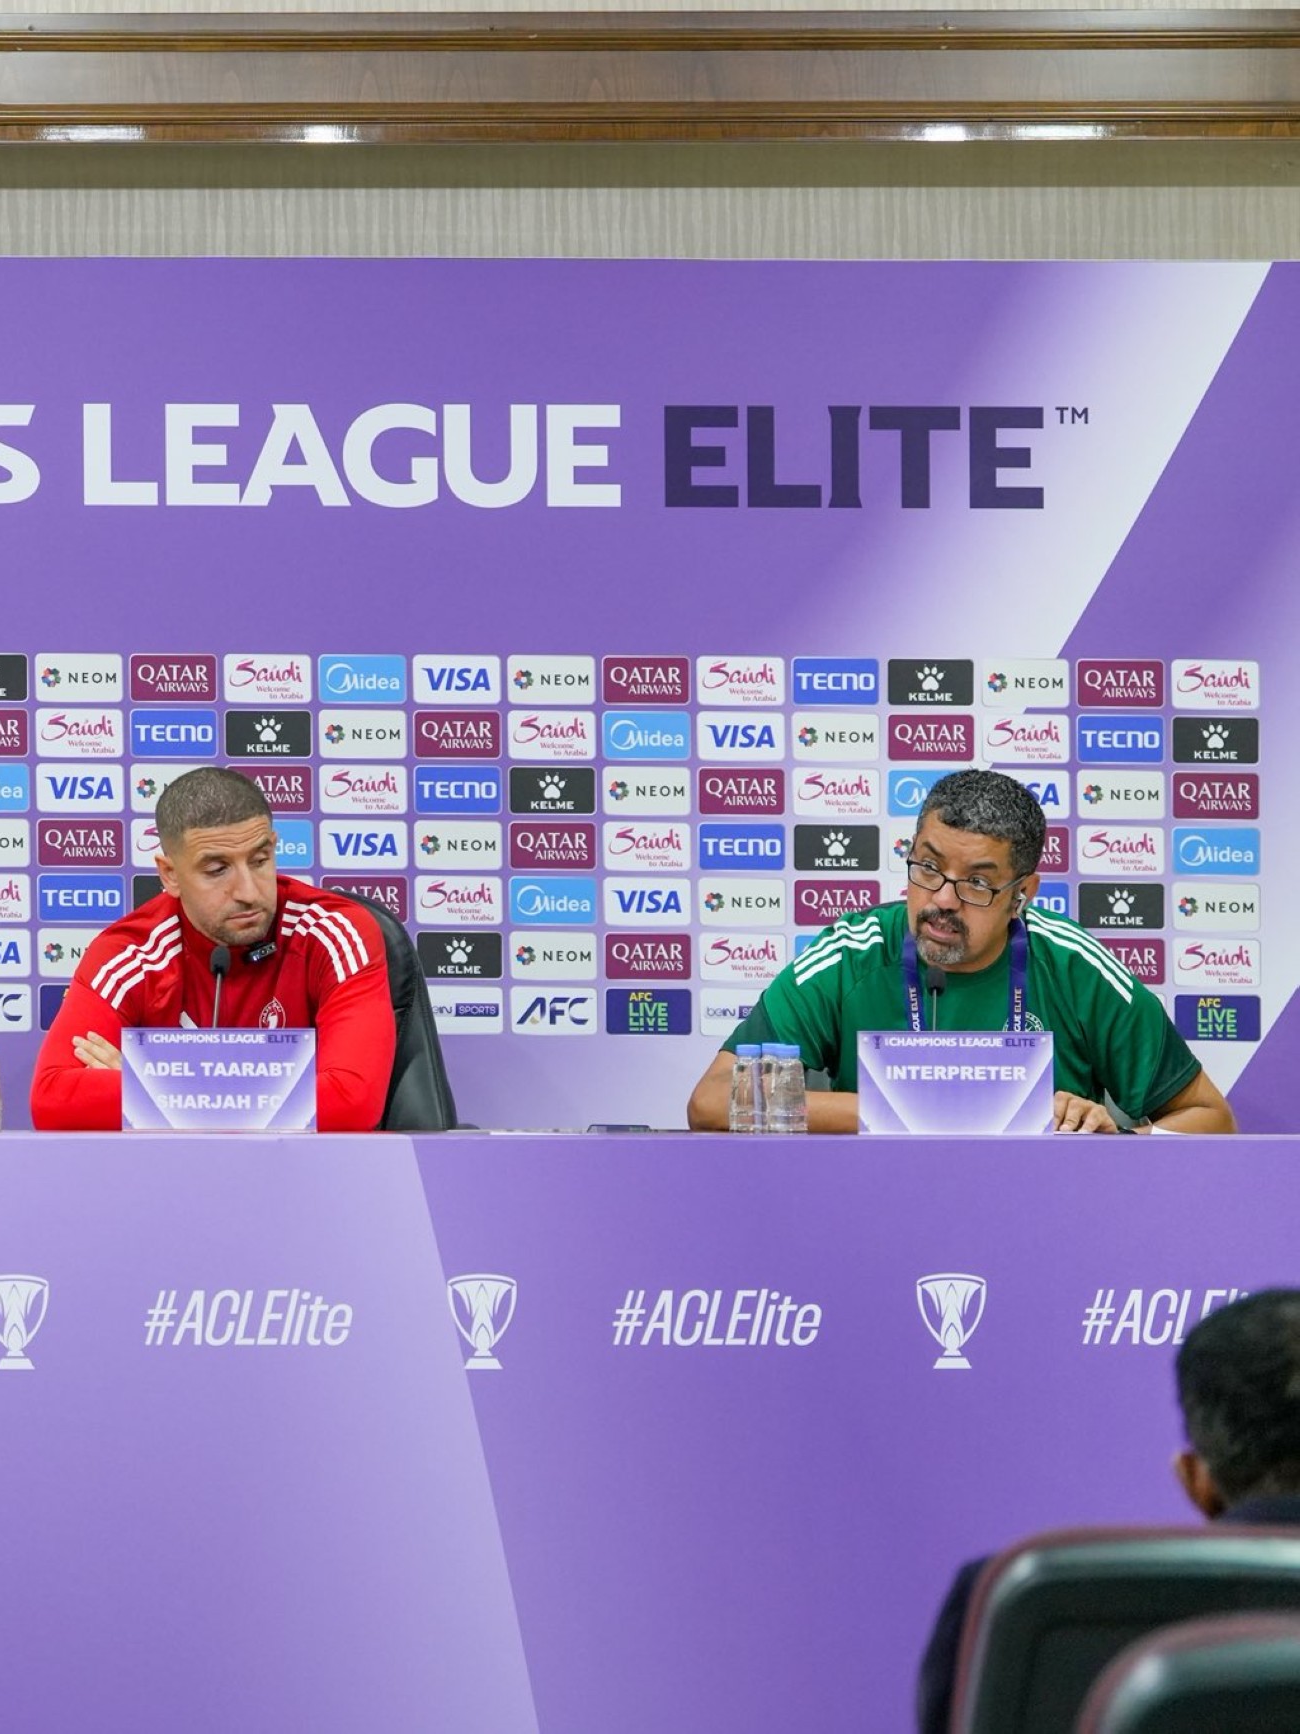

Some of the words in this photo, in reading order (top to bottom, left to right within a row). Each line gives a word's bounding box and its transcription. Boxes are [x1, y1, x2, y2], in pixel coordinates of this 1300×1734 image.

[83, 403, 621, 508] LEAGUE
[663, 405, 1044, 509] ELITE
[68, 672, 116, 684] NEOM
[326, 662, 400, 694] Midea
[420, 668, 490, 690] VISA
[610, 666, 680, 687] QATAR
[798, 672, 876, 690] TECNO
[1015, 677, 1064, 688] NEOM
[628, 684, 682, 695] AIRWAYS
[909, 692, 953, 702] KELME
[136, 724, 214, 742] TECNO
[352, 729, 400, 740] NEOM
[421, 720, 492, 741] QATAR
[610, 720, 684, 750] Midea
[706, 724, 776, 748] VISA
[895, 724, 966, 744] QATAR
[438, 738, 492, 749] AIRWAYS
[912, 741, 966, 752] AIRWAYS
[1082, 730, 1160, 748] TECNO
[247, 744, 291, 752] KELME
[1194, 750, 1238, 760] KELME
[254, 775, 304, 792] ATAR
[706, 778, 776, 798] QATAR
[264, 793, 305, 803] RWAYS
[531, 800, 575, 810] KELME
[724, 795, 778, 806] AIRWAYS
[276, 839, 307, 855] dea
[328, 832, 398, 856] VISA
[448, 840, 496, 852] NEOM
[517, 832, 588, 852] QATAR
[704, 838, 782, 856] TECNO
[534, 849, 588, 860] AIRWAYS
[1180, 836, 1253, 866] Midea
[815, 858, 859, 866] KELME
[518, 884, 591, 916] Midea
[612, 890, 682, 912] VISA
[732, 897, 780, 908] NEOM
[801, 889, 872, 909] QATAR
[1206, 902, 1254, 914] NEOM
[543, 951, 592, 962] NEOM
[612, 942, 682, 963] QATAR
[438, 966, 482, 974] KELME
[630, 960, 684, 971] AIRWAYS
[629, 992, 653, 1001] AFC
[1198, 998, 1222, 1007] AFC
[458, 1006, 497, 1015] SPORTS
[516, 997, 590, 1025] AFC
[629, 1002, 668, 1016] LIVE
[1198, 1008, 1237, 1022] LIVE
[152, 1034, 220, 1044] CHAMPIONS
[222, 1034, 266, 1044] LEAGUE
[268, 1034, 299, 1043] ELITE
[889, 1037, 957, 1047] CHAMPIONS
[959, 1037, 1003, 1047] LEAGUE
[1005, 1038, 1036, 1047] ELITE
[143, 1062, 195, 1077] ADEL
[201, 1062, 296, 1077] TAARABT
[886, 1065, 1027, 1081] INTERPRETER
[157, 1094, 251, 1109] SHARJAH
[258, 1094, 282, 1109] FC
[144, 1289, 352, 1346] #ACLElite
[612, 1288, 822, 1346] #ACLElite
